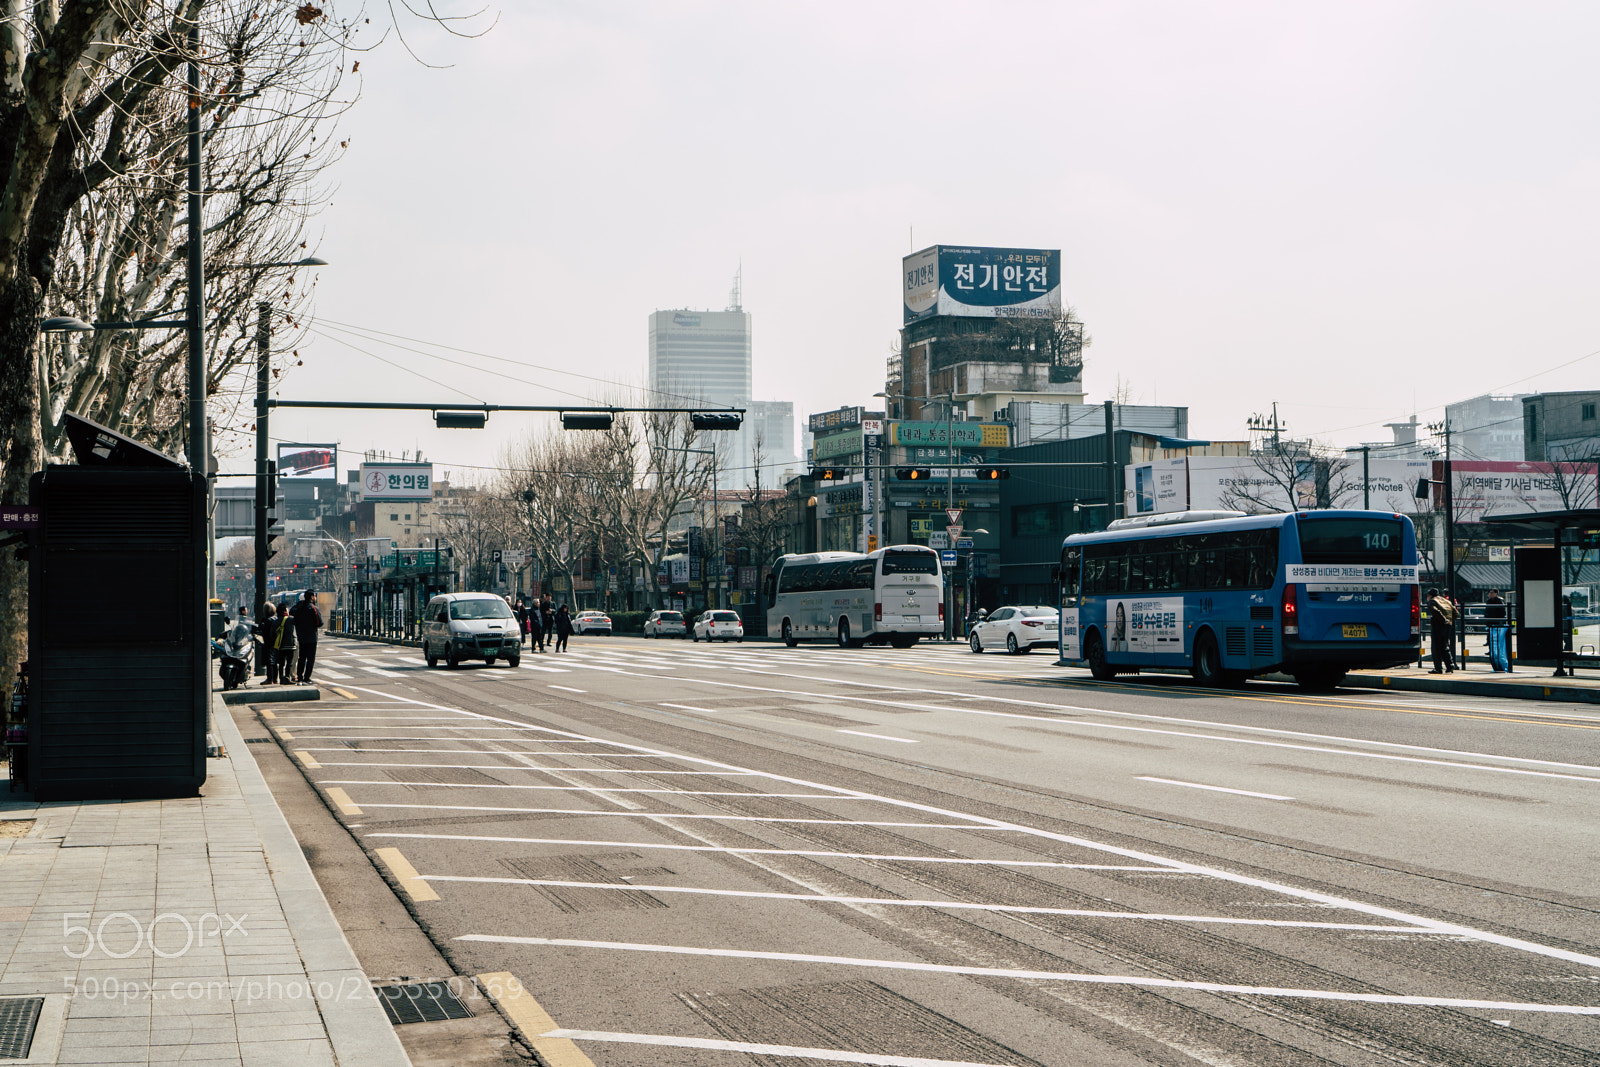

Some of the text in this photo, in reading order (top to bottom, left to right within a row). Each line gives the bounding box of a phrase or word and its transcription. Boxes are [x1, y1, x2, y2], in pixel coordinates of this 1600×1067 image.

[907, 262, 934, 290] 전기안전
[953, 263, 1047, 292] 전기안전
[388, 474, 429, 490] 한의원
[1378, 483, 1403, 492] Note8
[1465, 477, 1502, 491] 지역배달
[1505, 478, 1531, 490] 기사님
[1363, 533, 1390, 549] 140
[493, 551, 501, 561] P
[1291, 567, 1415, 577] 삼성증권 비대면 계좌는 평생 수수료 무료
[1199, 597, 1213, 614] 140
[1144, 612, 1162, 630] 수수료
